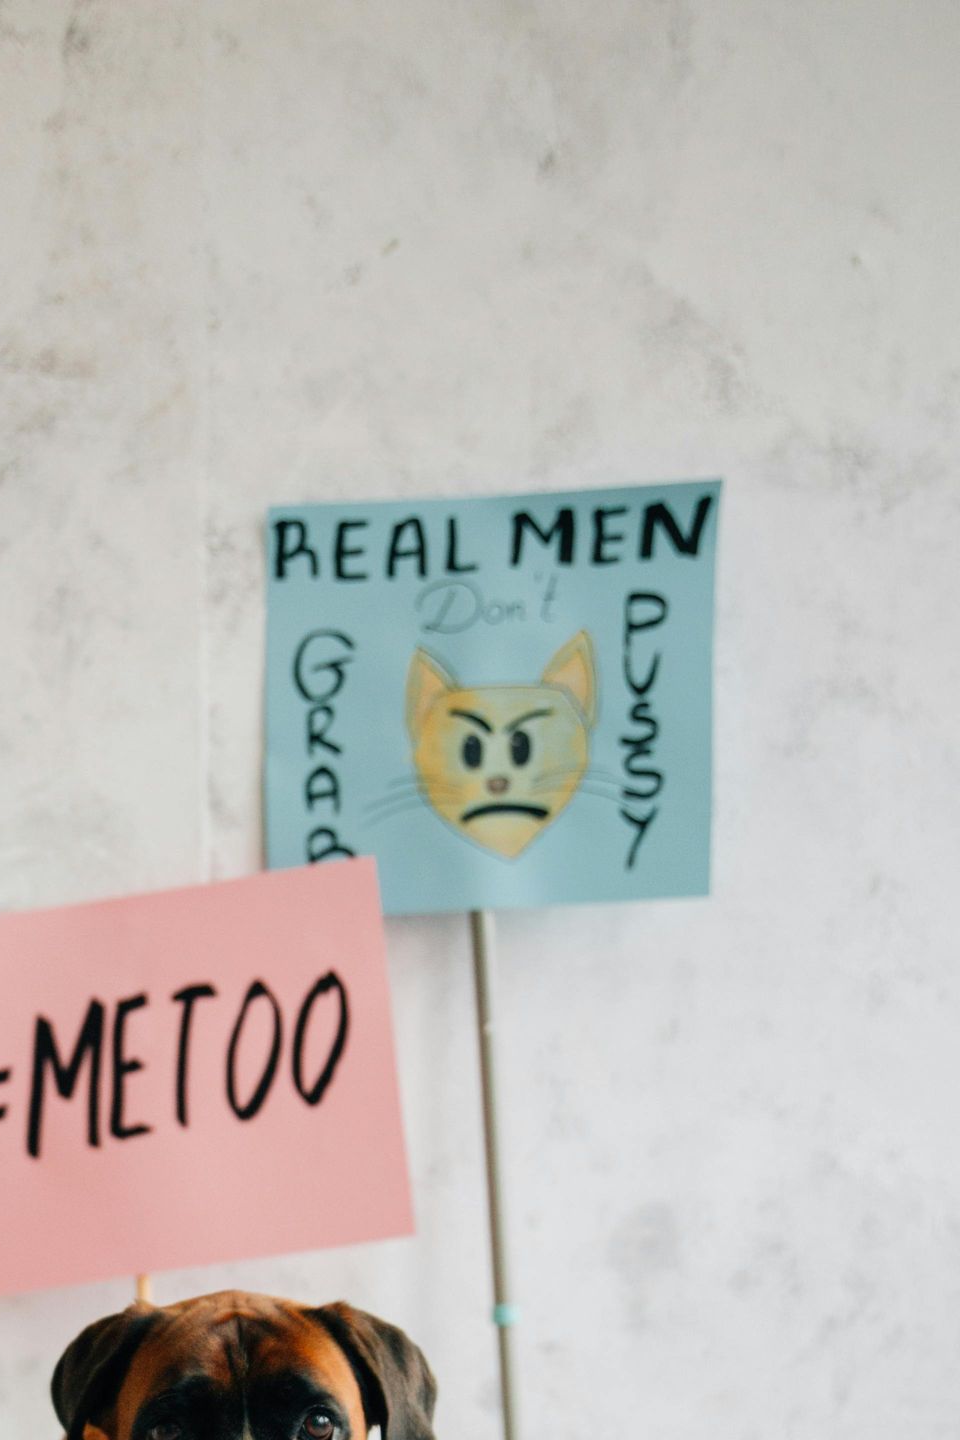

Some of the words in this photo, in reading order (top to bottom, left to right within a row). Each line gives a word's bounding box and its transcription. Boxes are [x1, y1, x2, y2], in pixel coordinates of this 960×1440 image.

[273, 516, 478, 582] REAL
[509, 494, 714, 567] MEN
[620, 591, 669, 870] PUSSY
